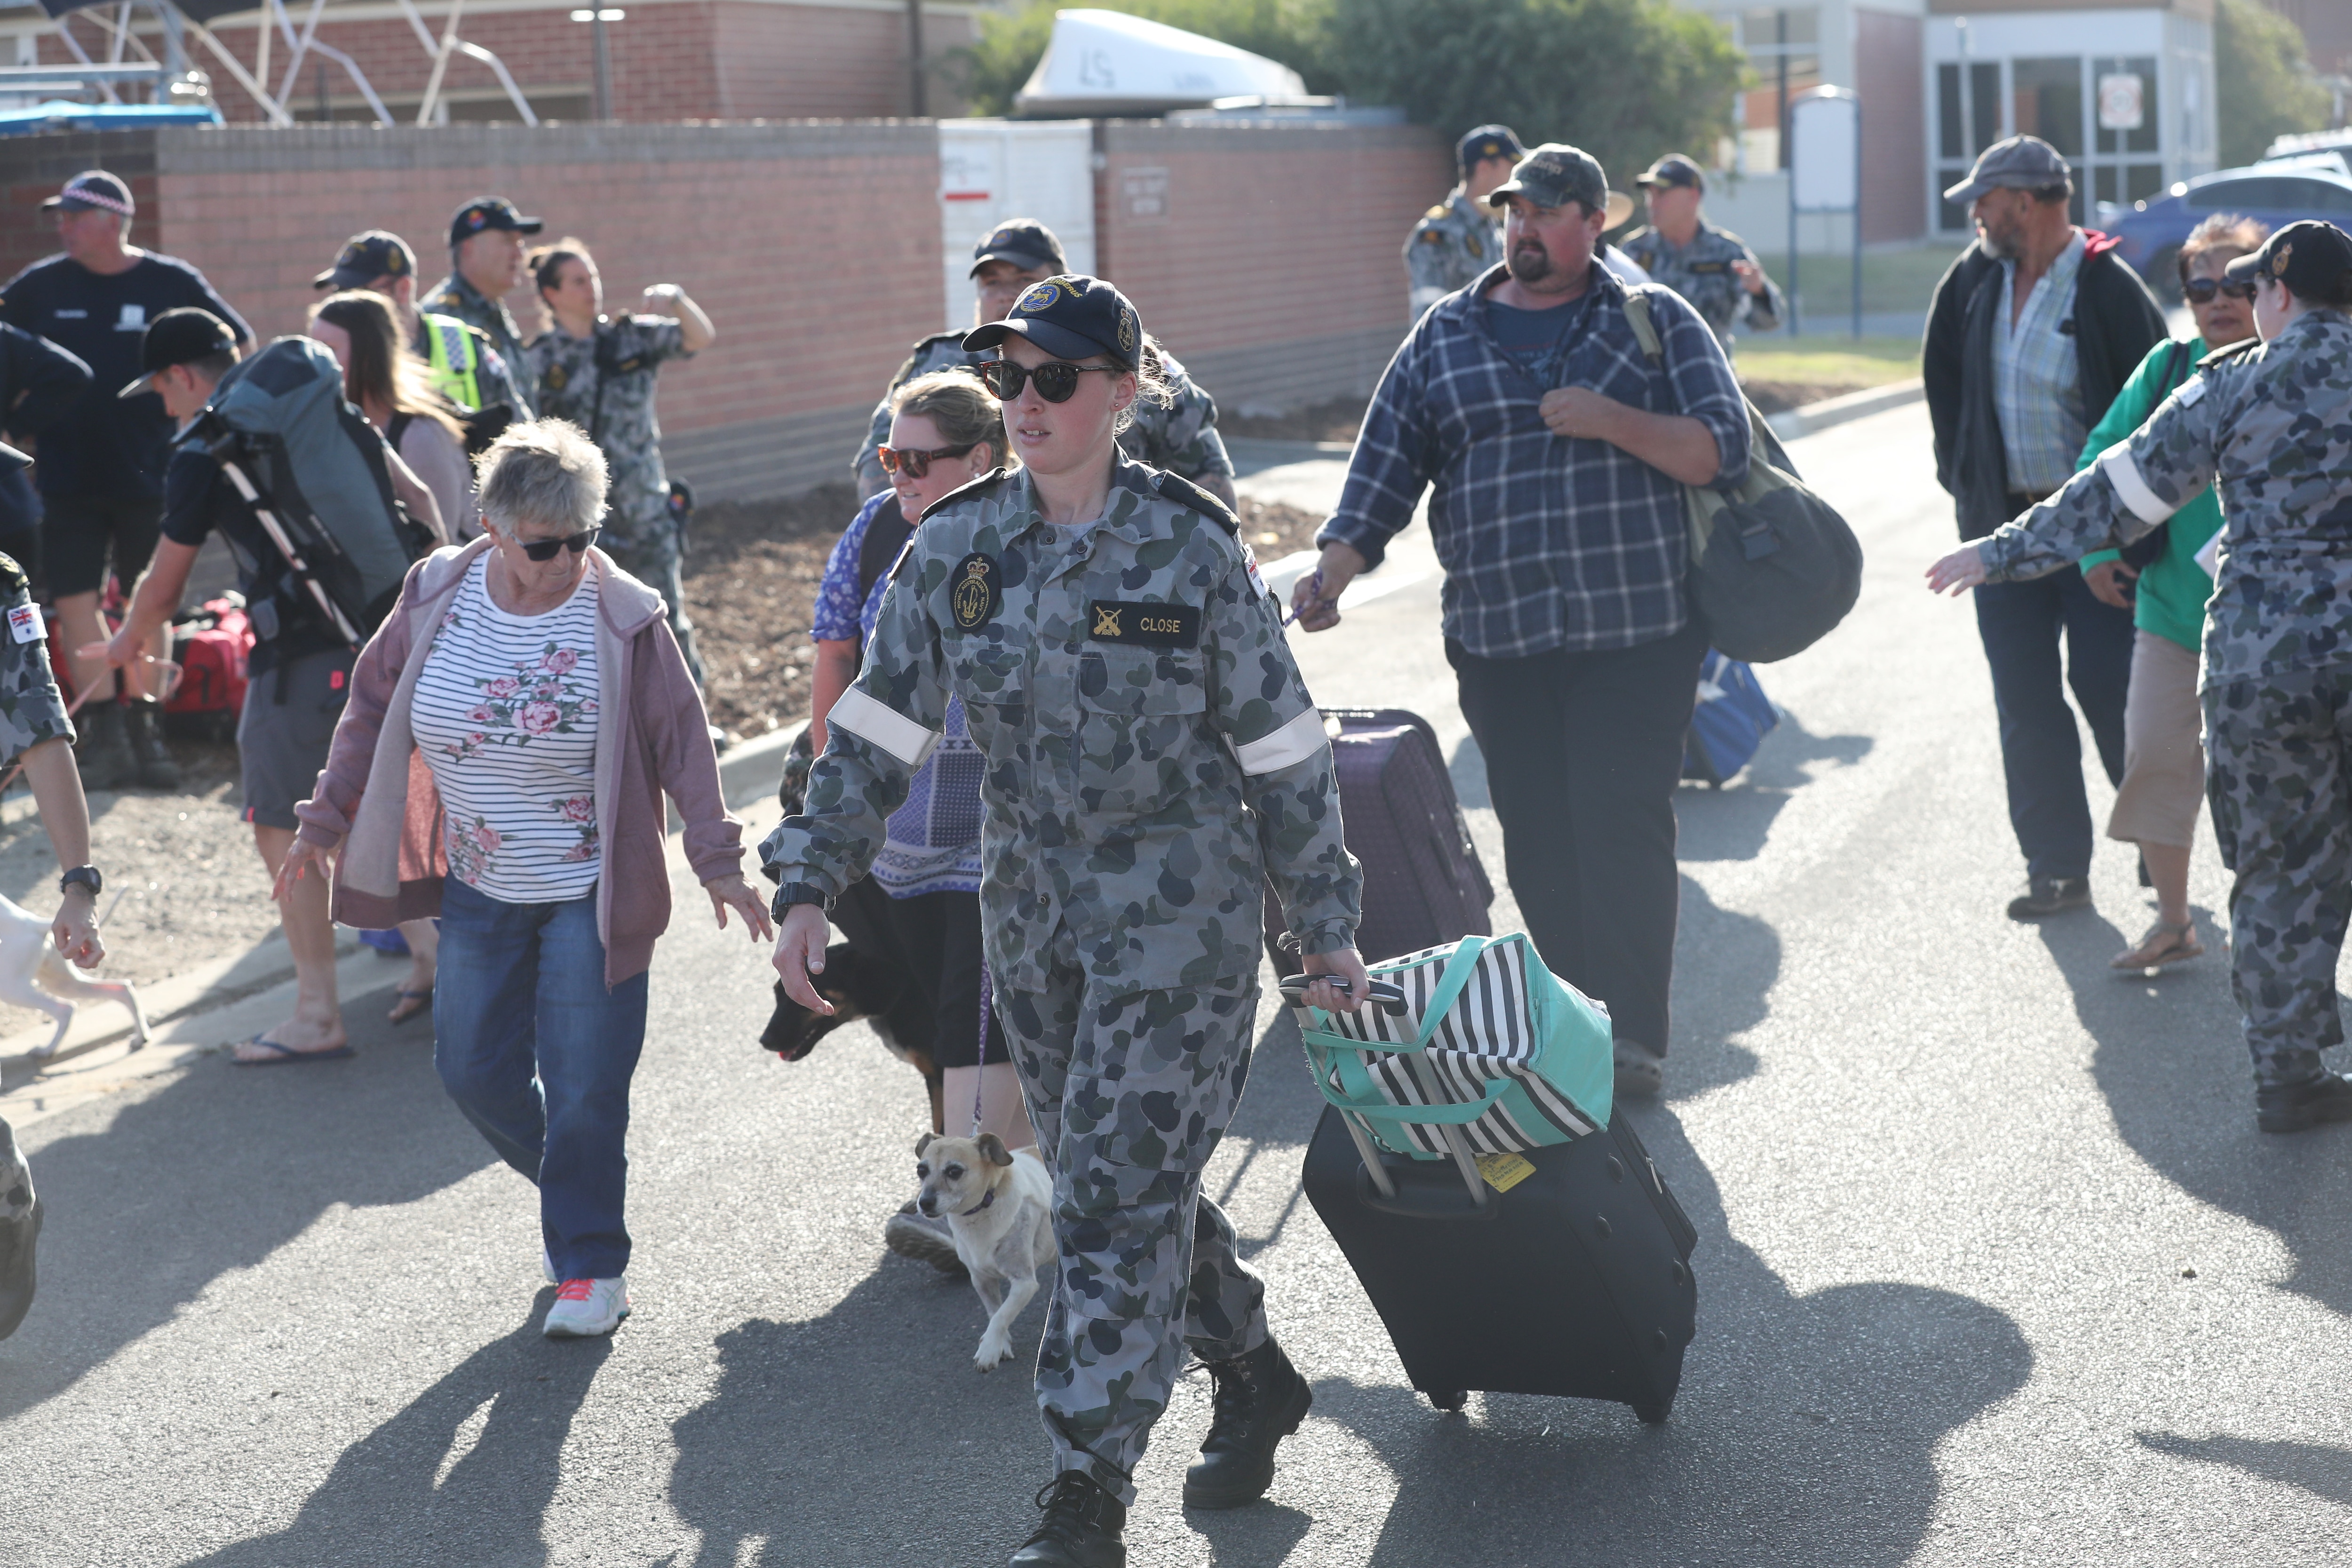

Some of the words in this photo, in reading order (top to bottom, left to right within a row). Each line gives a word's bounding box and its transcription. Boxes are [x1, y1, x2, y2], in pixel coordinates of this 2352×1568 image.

[1045, 278, 1083, 297] CERBERUS
[961, 580, 985, 593] AUSTRALIAN
[1140, 618, 1180, 633] CLOSE
